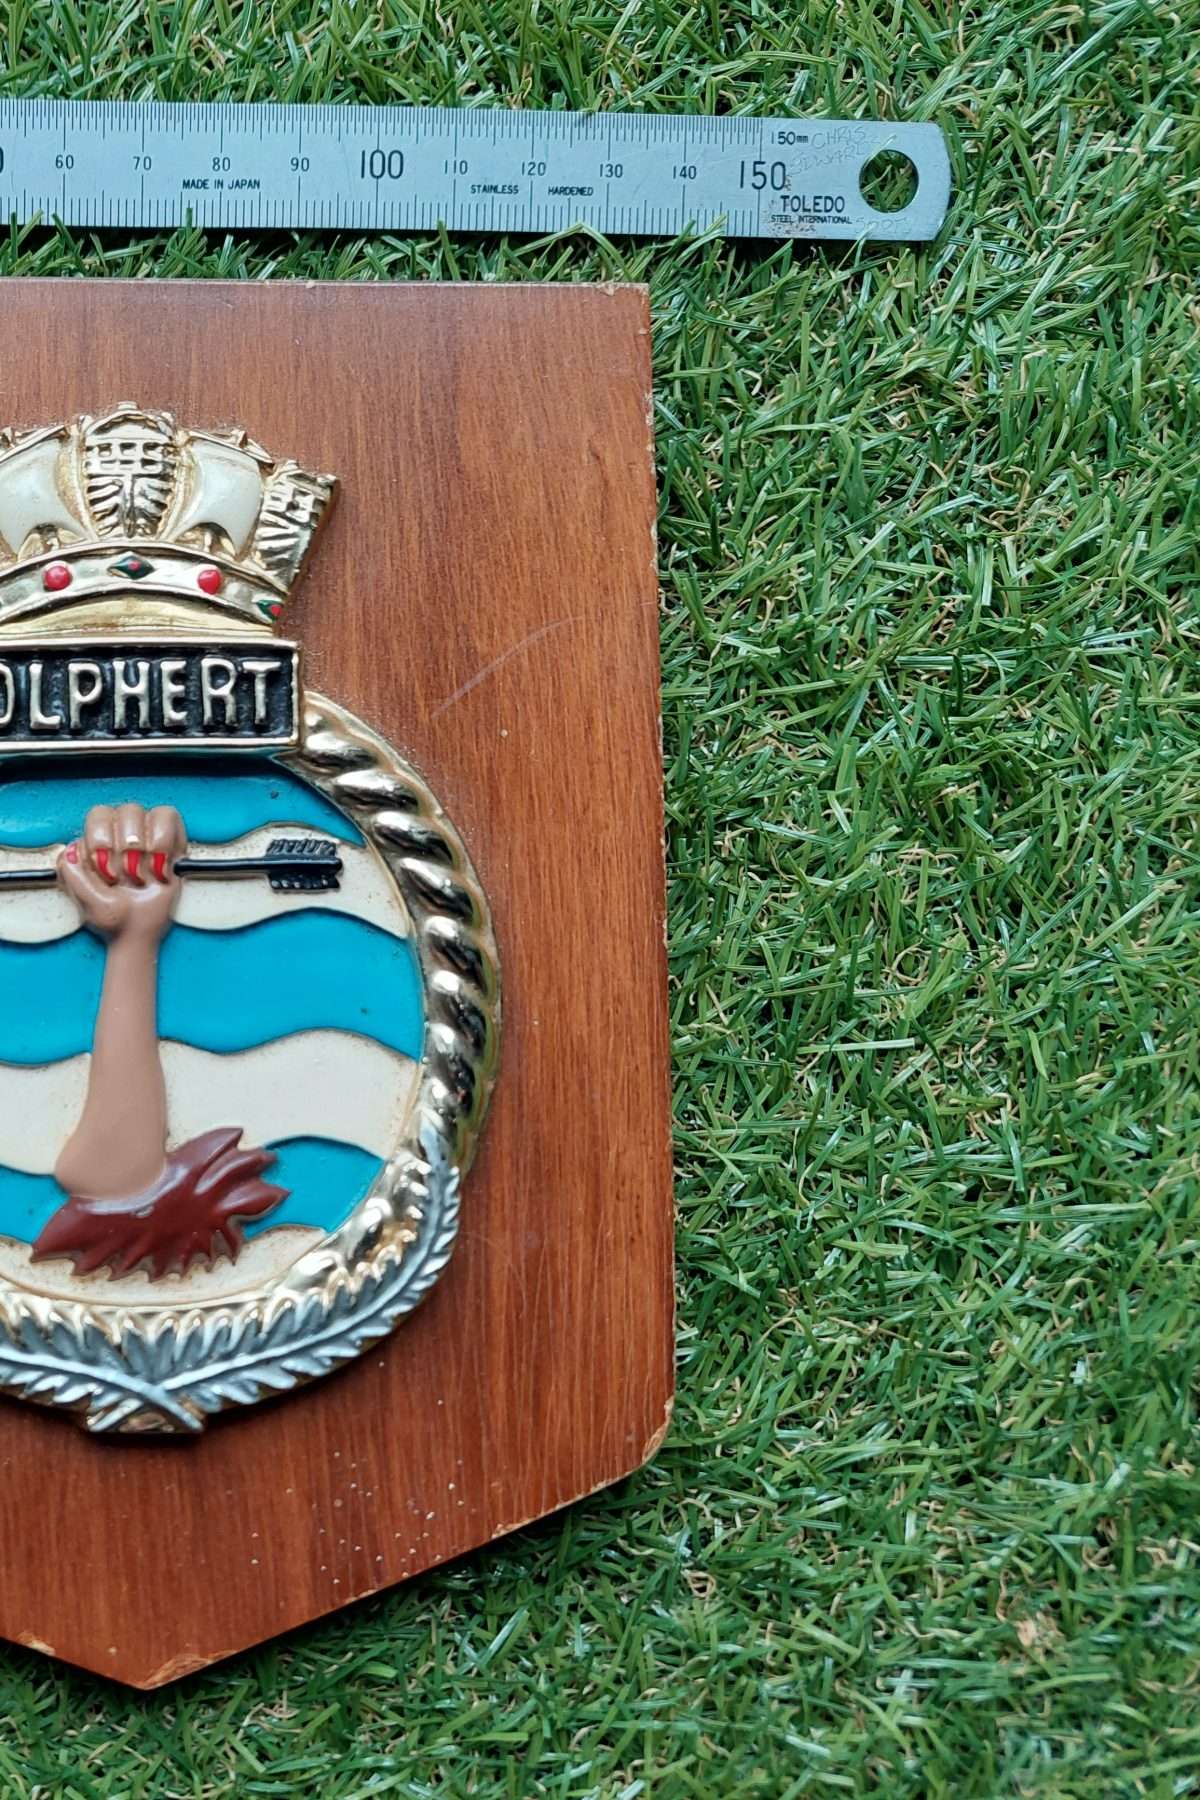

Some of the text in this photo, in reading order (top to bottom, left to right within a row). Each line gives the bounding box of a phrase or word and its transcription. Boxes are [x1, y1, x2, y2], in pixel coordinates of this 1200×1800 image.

[55, 154, 74, 169] 60
[133, 155, 152, 170] 70
[212, 156, 231, 172] 80
[290, 156, 309, 172] 90
[360, 149, 404, 179] 100
[444, 159, 468, 175] 110
[521, 161, 546, 177] 120
[599, 163, 623, 178] 130
[673, 165, 697, 180] 140
[739, 160, 786, 190] 150
[182, 179, 260, 190] MADE IN JAPAN
[471, 184, 594, 197] STAINLESS HARDENED
[780, 195, 845, 213] TOLEDO
[771, 215, 794, 224] STEEL
[798, 215, 852, 225] INTERNATIONAL
